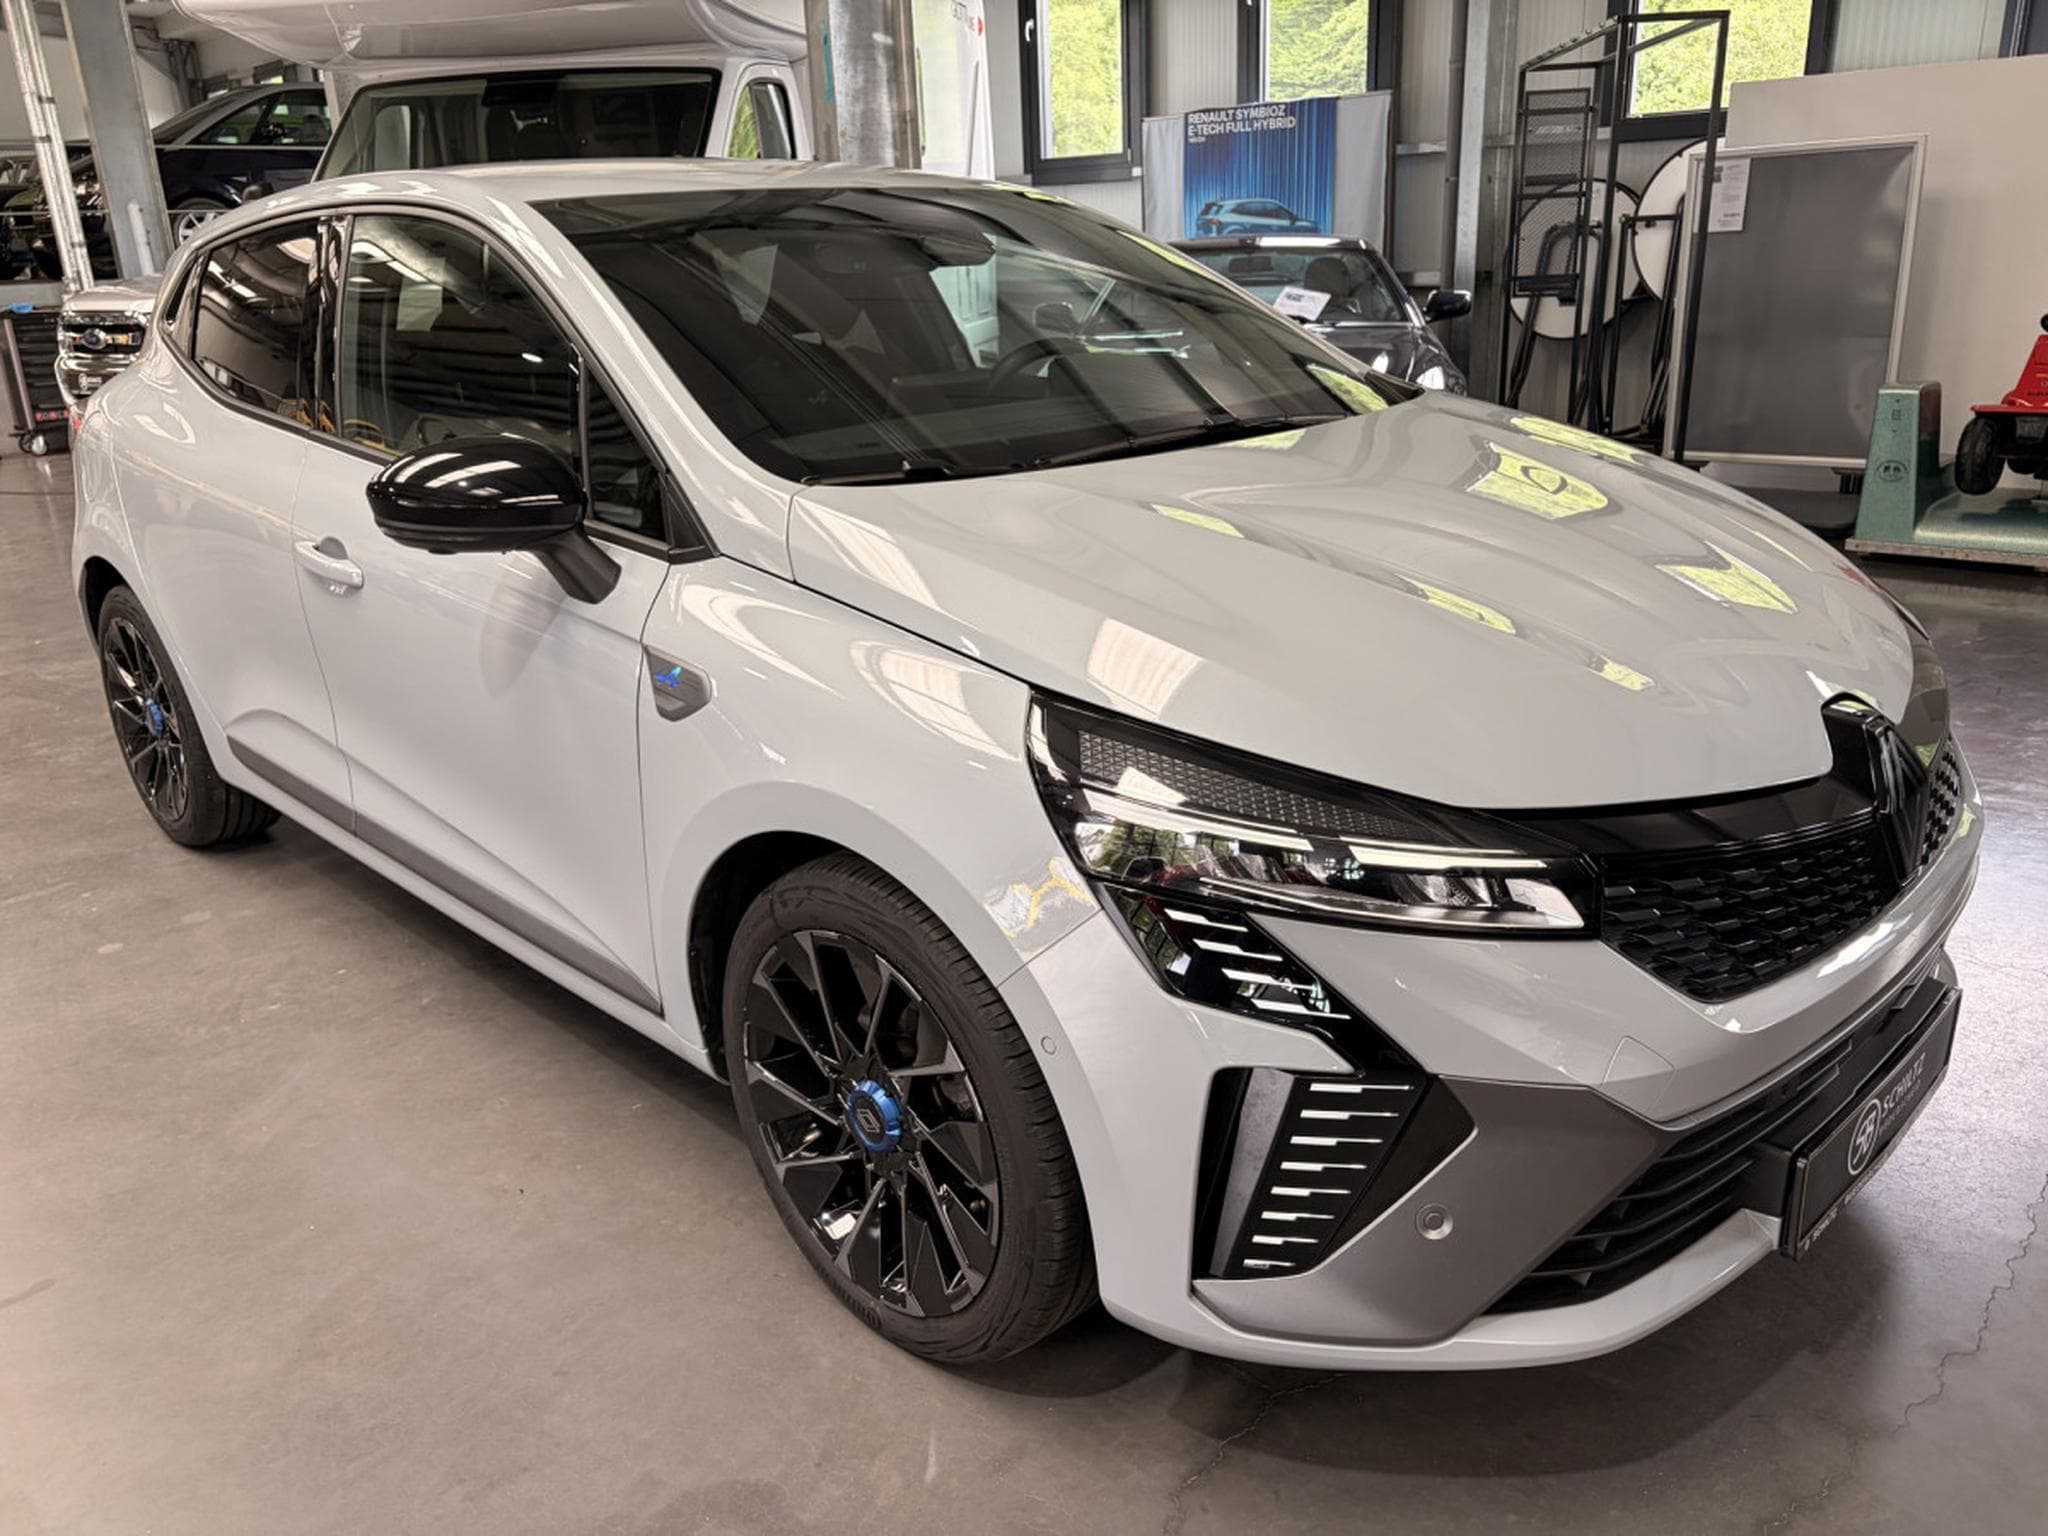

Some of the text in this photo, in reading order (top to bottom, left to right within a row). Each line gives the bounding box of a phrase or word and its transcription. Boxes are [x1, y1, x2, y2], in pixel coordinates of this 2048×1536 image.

[1188, 105, 1286, 122] RENAULT SYMBIOZ
[1188, 116, 1296, 136] E-TECH FULL HYBRID
